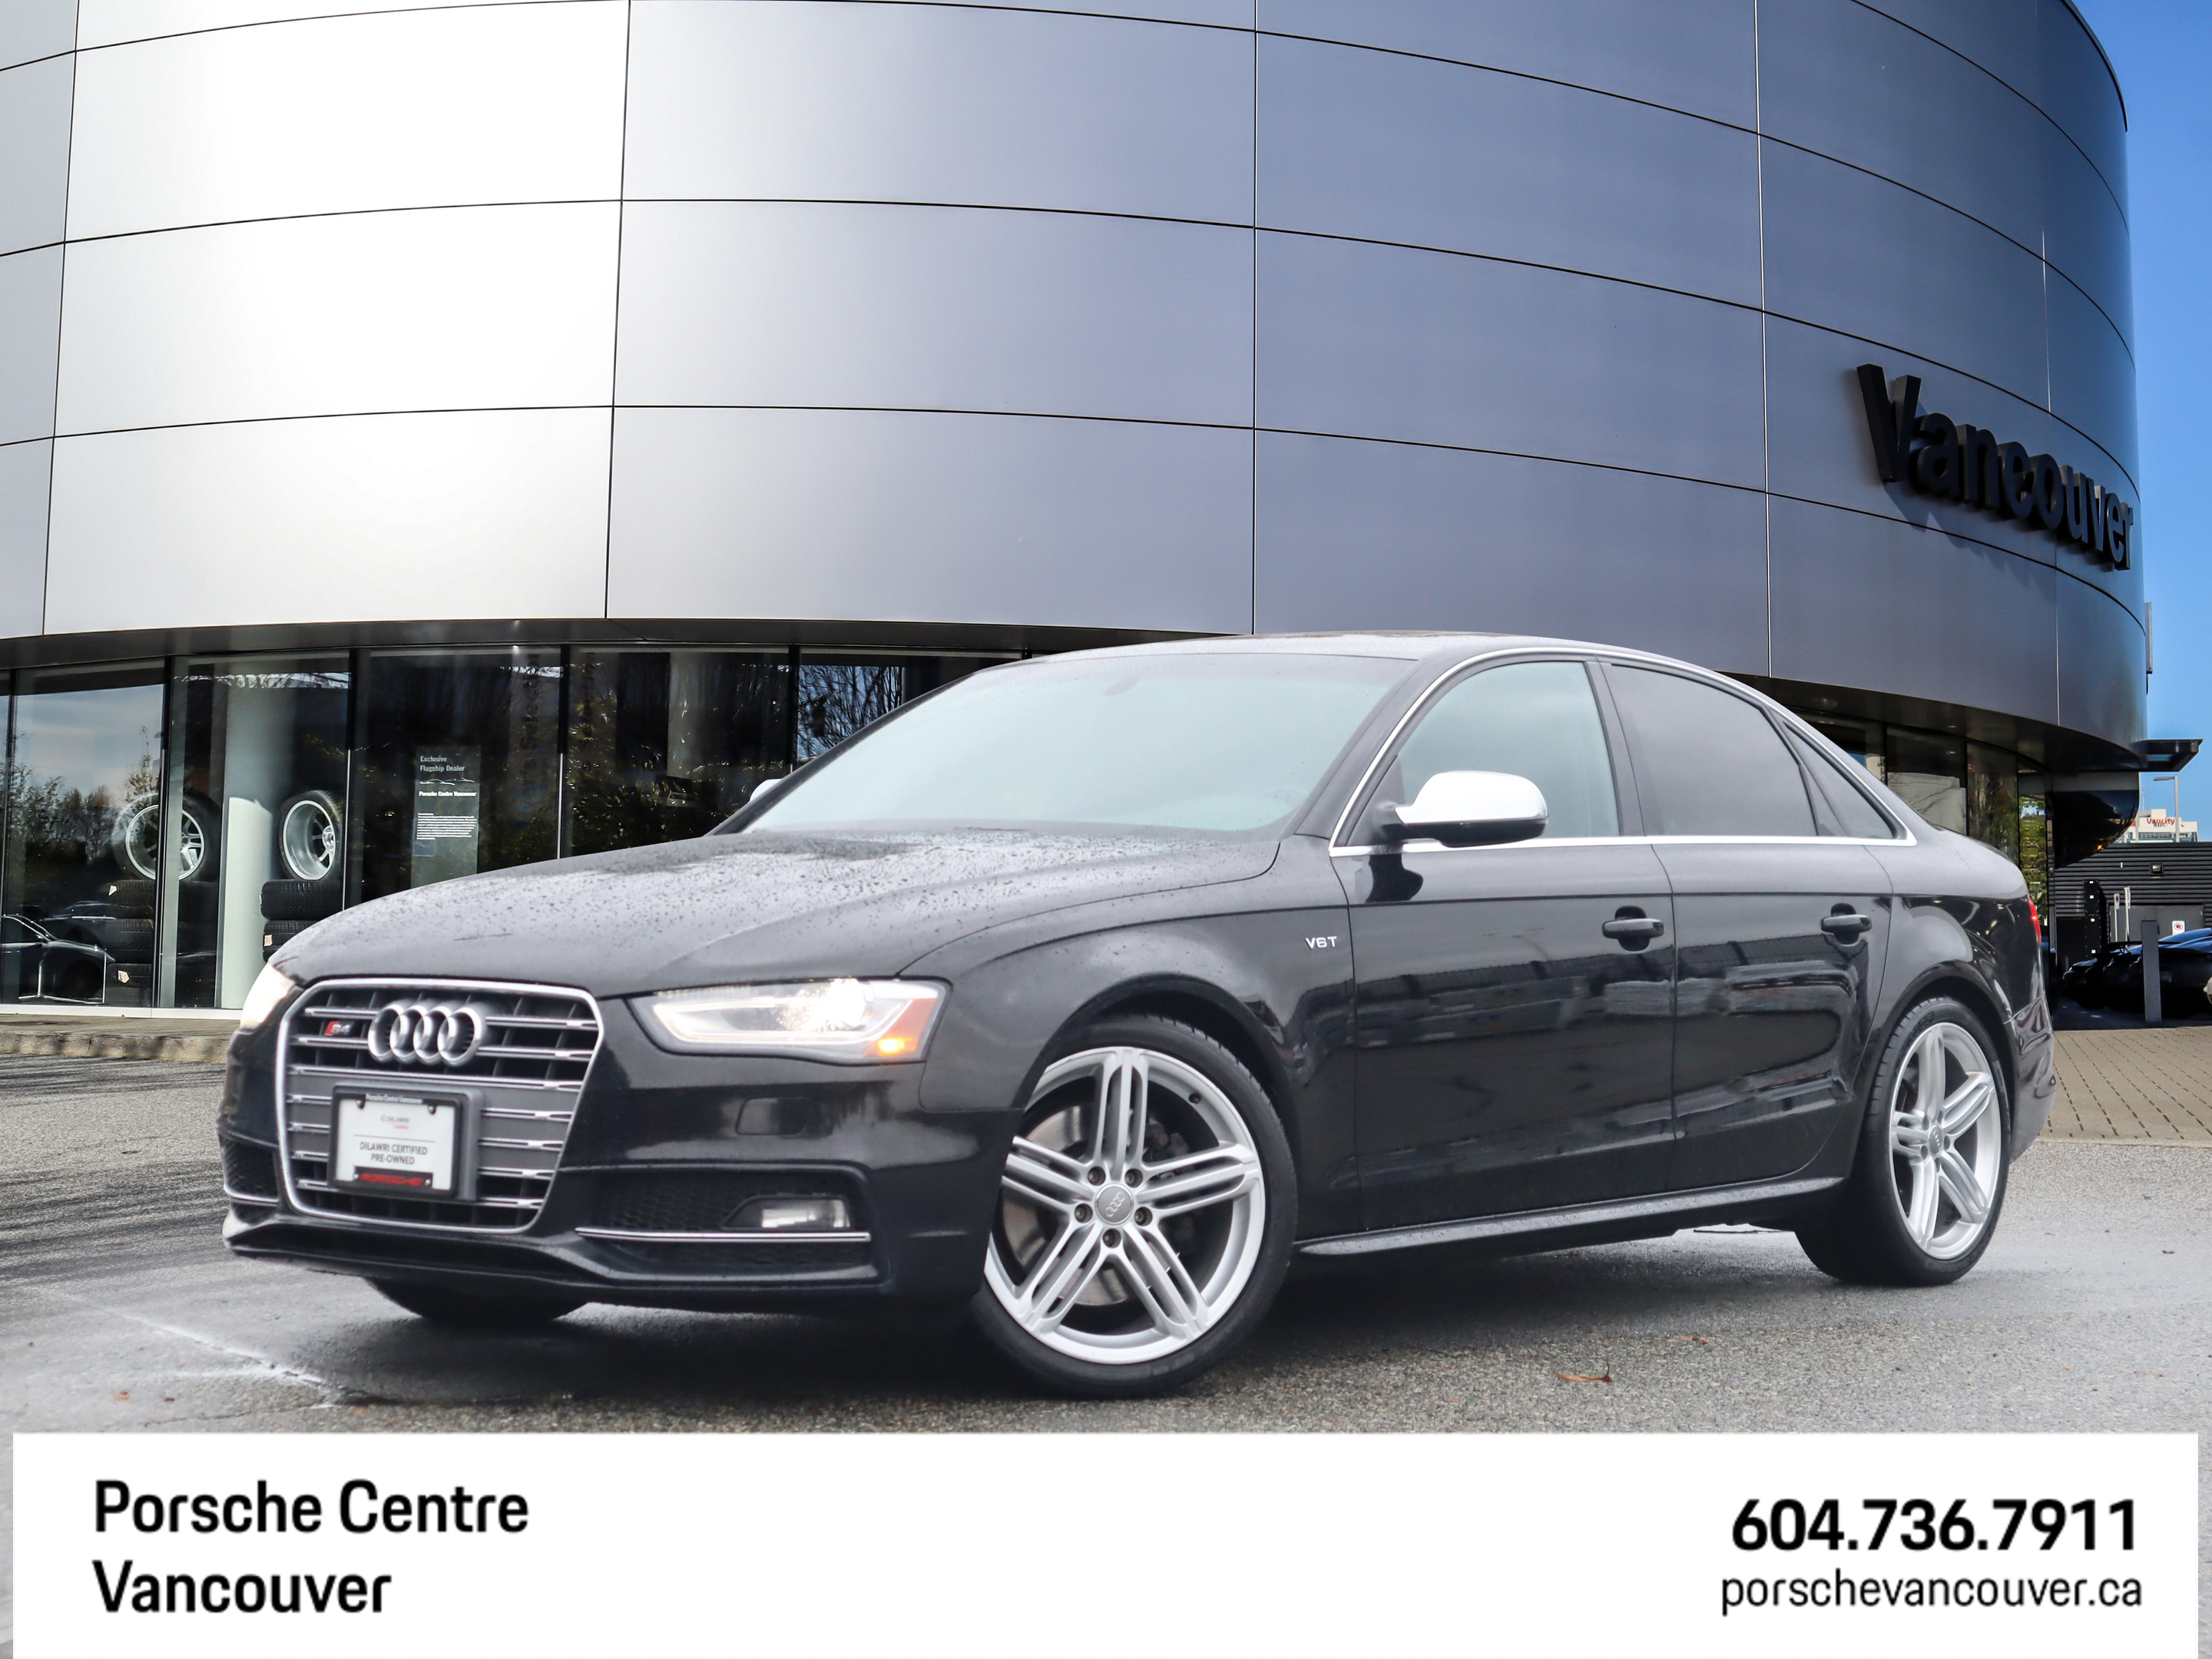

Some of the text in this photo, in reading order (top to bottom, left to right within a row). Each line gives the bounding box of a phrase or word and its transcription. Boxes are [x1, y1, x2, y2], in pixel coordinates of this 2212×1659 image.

[1856, 363, 2134, 571] Vancouver
[419, 764, 445, 773] Flagship
[2146, 817, 2175, 826] Vancity
[1305, 935, 1338, 949] V6T
[359, 1141, 428, 1155] DILAWRI CERTIFIED
[371, 1154, 415, 1165] PRE-OWNED
